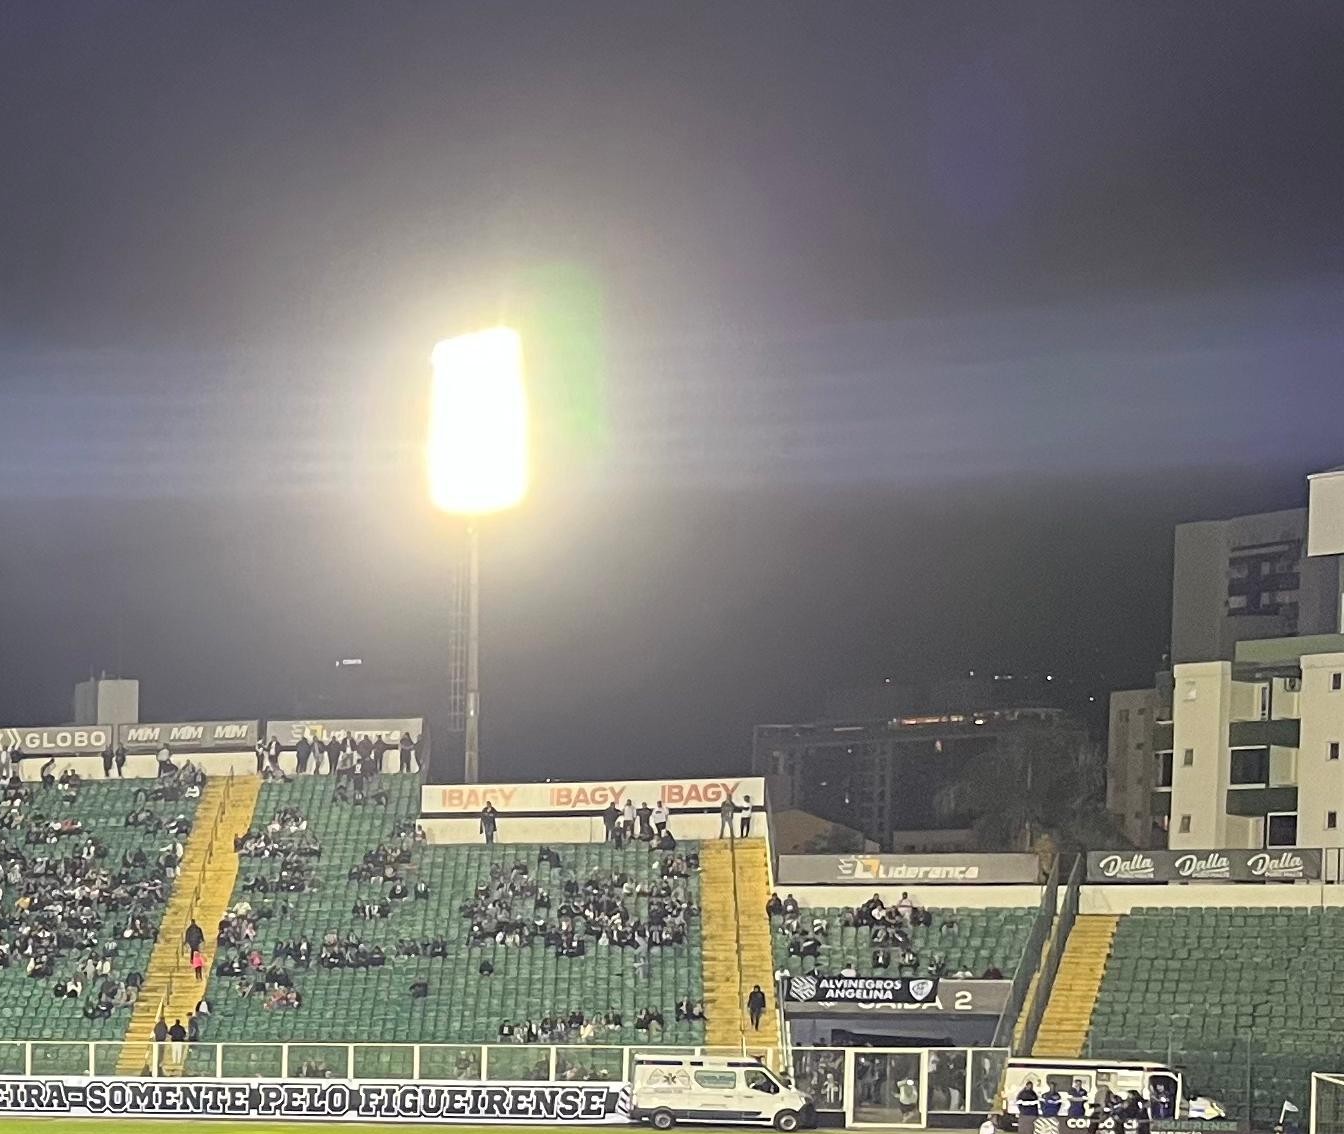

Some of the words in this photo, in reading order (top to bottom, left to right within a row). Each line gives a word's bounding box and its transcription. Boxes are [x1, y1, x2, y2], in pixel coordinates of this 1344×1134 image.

[25, 731, 106, 748] GLOBO
[442, 787, 517, 808] IBAGY
[549, 786, 627, 808] IBAGY
[661, 783, 740, 804] IBAGY
[878, 864, 979, 881] Liderança
[1099, 854, 1154, 876] Dalla
[1174, 853, 1229, 876] Dalla
[1247, 853, 1303, 876] Dalla
[819, 979, 902, 990] ALVINEGROS
[825, 988, 893, 1000] ANGELINA
[262, 1086, 349, 1112] PELO
[359, 1087, 606, 1116] FIGUEIRENSE
